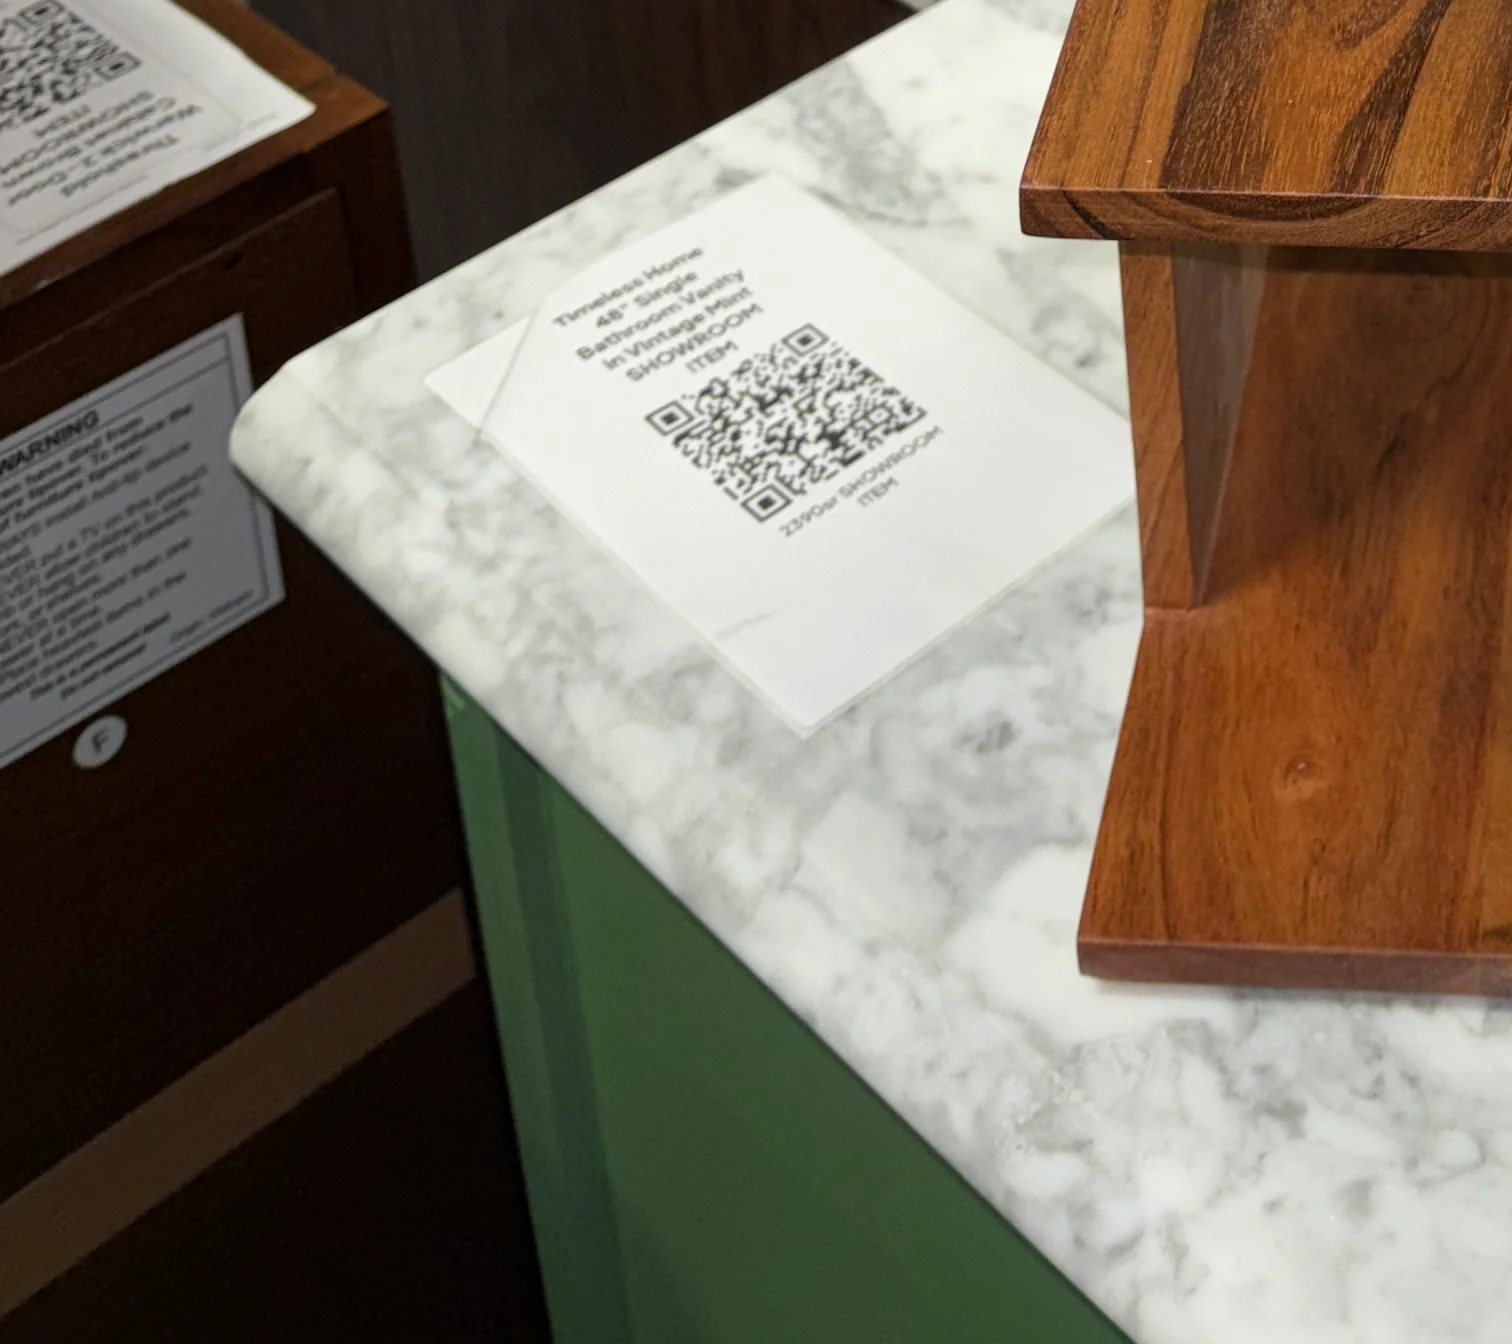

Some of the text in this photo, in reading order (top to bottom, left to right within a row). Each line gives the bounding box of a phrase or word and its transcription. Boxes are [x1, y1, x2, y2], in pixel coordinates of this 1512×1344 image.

[552, 247, 704, 327] Timeless Home
[633, 271, 698, 309] Single
[704, 287, 752, 315] Mint
[575, 269, 744, 361] Bathroom Vanity
[626, 302, 763, 382] SHOWROOM
[685, 338, 738, 373] ITEM
[838, 425, 943, 498] SHOWROOM
[857, 476, 898, 509] ITEM
[92, 727, 110, 753] F
